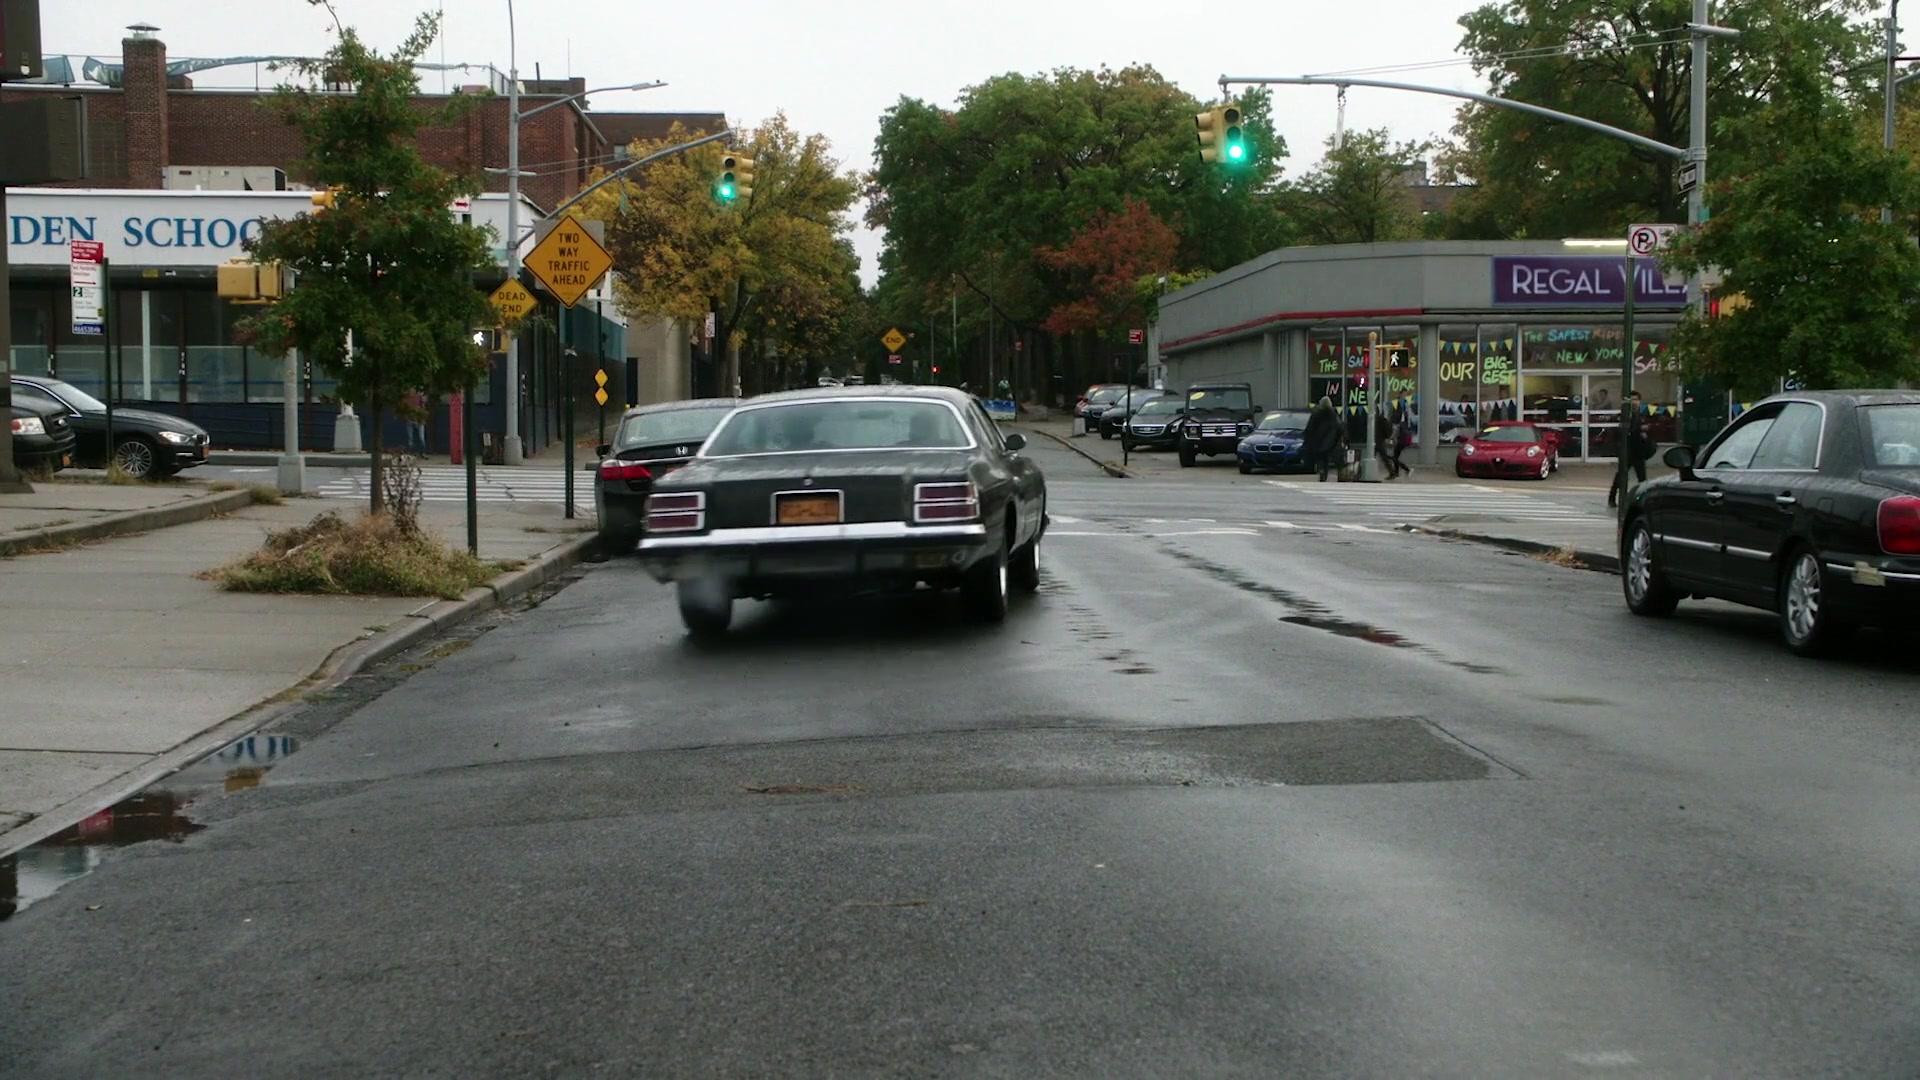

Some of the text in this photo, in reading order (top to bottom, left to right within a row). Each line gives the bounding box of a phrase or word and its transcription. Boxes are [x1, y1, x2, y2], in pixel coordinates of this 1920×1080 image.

[558, 233, 580, 244] TWO
[558, 247, 579, 257] WAY
[548, 261, 590, 271] TRAFFIC
[552, 275, 586, 285] AHEAD
[1512, 264, 1611, 294] REGAL
[74, 287, 82, 297] 2
[498, 292, 526, 301] DEAD
[502, 304, 522, 313] END
[1548, 328, 1590, 342] SAFEST
[1556, 349, 1589, 364] NEW
[1483, 356, 1513, 370] BIG-
[1440, 362, 1475, 382] OUR
[1481, 369, 1517, 385] GEST
[1326, 381, 1339, 396] IN
[1386, 375, 1416, 392] YORK
